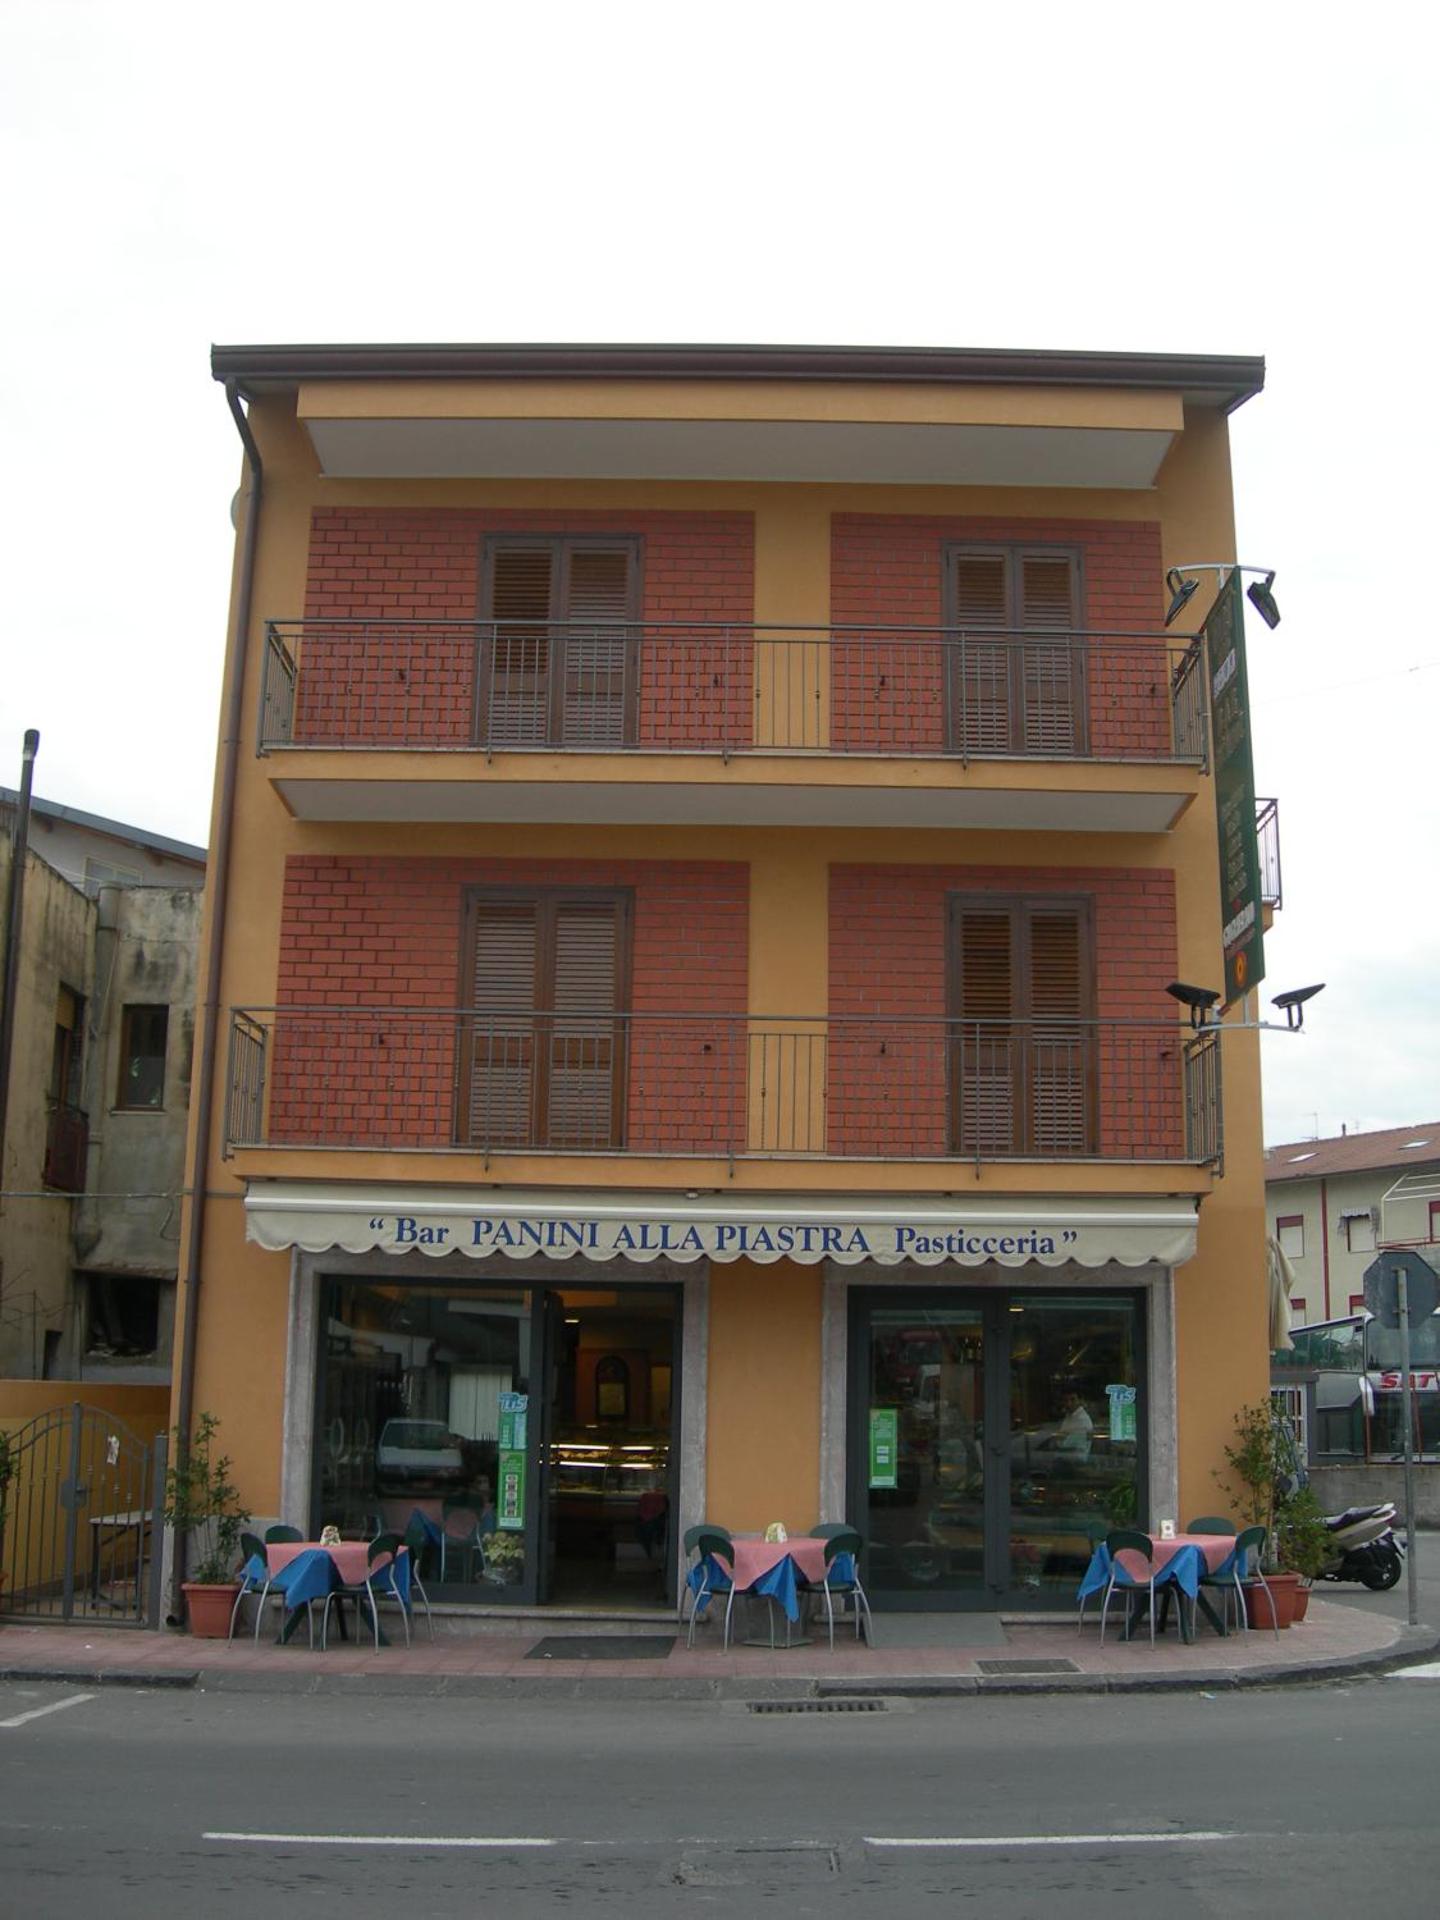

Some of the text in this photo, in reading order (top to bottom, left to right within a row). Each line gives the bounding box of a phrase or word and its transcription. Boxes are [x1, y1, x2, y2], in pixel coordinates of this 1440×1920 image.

[472, 1219, 599, 1247] PANINI
[613, 1225, 703, 1250] ALLA
[715, 1225, 870, 1252] PIASTRA
